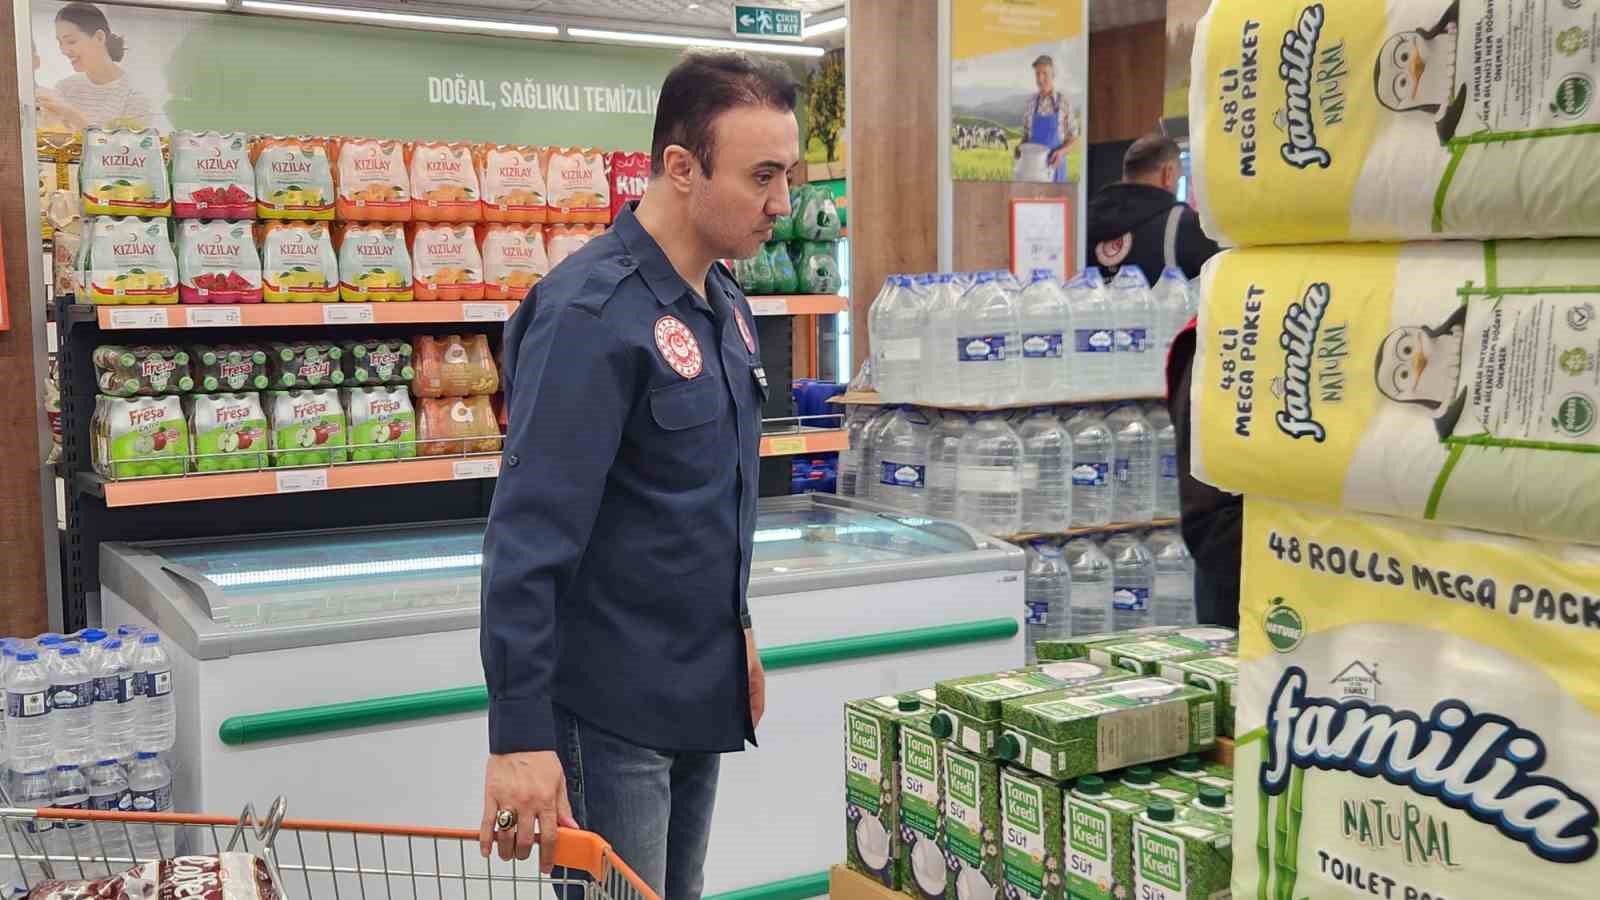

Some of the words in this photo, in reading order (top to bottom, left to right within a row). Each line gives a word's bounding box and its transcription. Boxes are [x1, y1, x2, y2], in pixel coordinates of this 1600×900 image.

[776, 24, 799, 34] EXIT
[1242, 20, 1260, 100] PAKET
[428, 72, 496, 110] DOĞAL,
[500, 77, 580, 111] SAĞLIKLI
[1279, 3, 1332, 169] familia
[1317, 38, 1347, 126] NATURAL
[1240, 107, 1256, 176] MEGA
[1240, 284, 1264, 362] PAKET
[1218, 328, 1238, 390] 48'Lİ
[1276, 282, 1330, 443] familia
[1318, 321, 1348, 402] NATURAL
[1235, 370, 1254, 437] MEGA
[1269, 532, 1301, 564] 48
[1309, 542, 1404, 586] ROLLS
[1411, 564, 1497, 610] MEGA
[1508, 584, 1600, 630] PACK
[1267, 622, 1301, 640] NATURE
[851, 716, 878, 737] Tarım
[852, 729, 876, 751] Kredi
[906, 733, 934, 755] Tarım
[850, 754, 868, 774] Süt
[908, 748, 933, 770] Kredi
[949, 758, 975, 782] Tarım
[1260, 666, 1599, 864] familia
[906, 776, 924, 794] Süt
[951, 774, 974, 797] Kredi
[1006, 781, 1038, 803] Tarım
[950, 802, 967, 820] Süt
[1008, 800, 1037, 824] Kredi
[1072, 804, 1104, 830] Tarım
[1008, 827, 1028, 848] Süt
[1073, 823, 1103, 849] Kredi
[1140, 830, 1178, 857] Tarım
[1342, 799, 1462, 868] NATURAL
[1071, 854, 1093, 876] Süt
[1143, 852, 1176, 880] Kredi
[1318, 850, 1396, 900] TOILET
[1142, 884, 1164, 900] Süt
